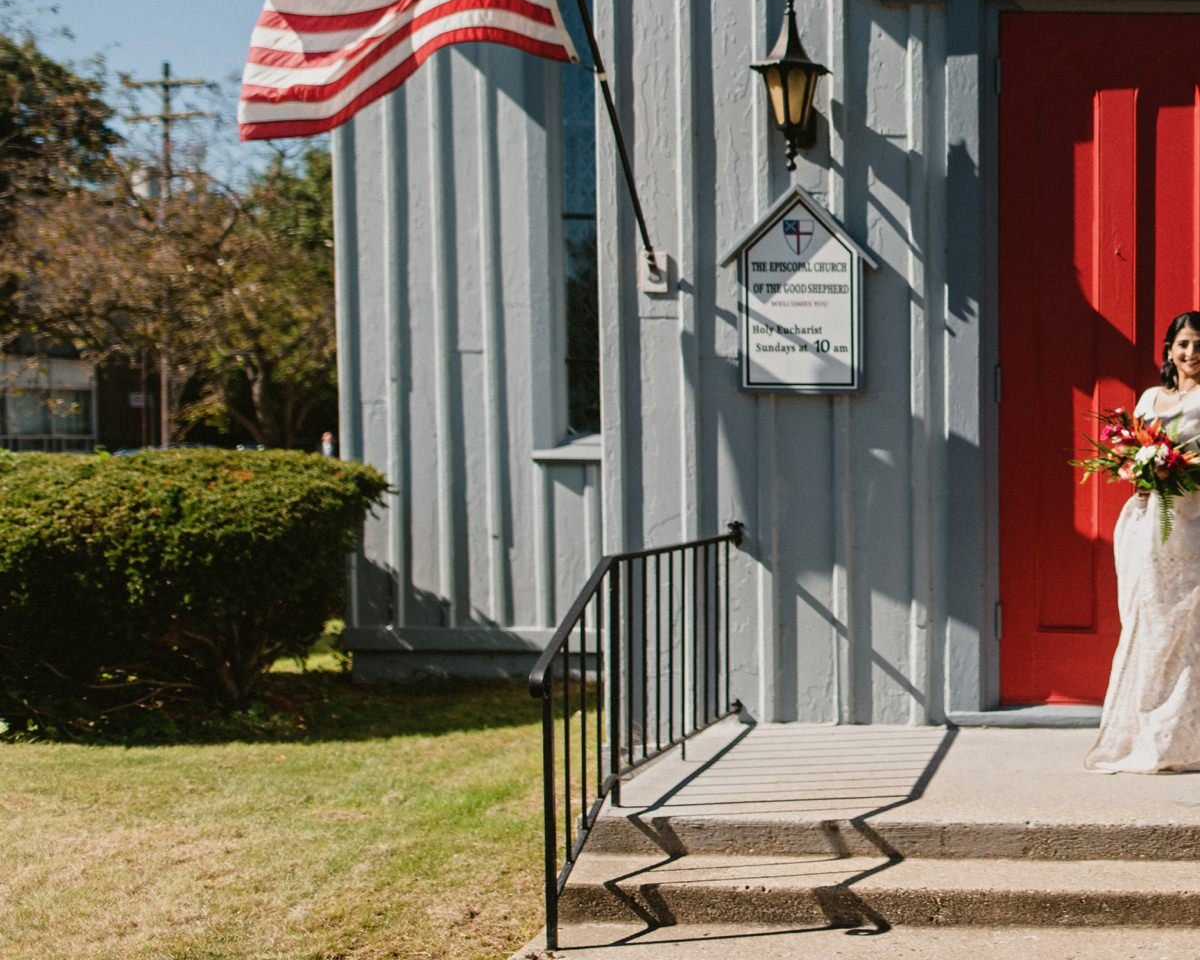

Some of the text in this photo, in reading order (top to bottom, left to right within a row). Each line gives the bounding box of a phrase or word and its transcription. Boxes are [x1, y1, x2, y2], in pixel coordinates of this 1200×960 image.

[752, 262, 847, 272] THE EPISCOPAL CHURCH
[753, 283, 849, 294] OF THE GOOD SHEPHERD
[753, 324, 822, 336] Holy Eucharist
[756, 342, 796, 354] Sundays
[799, 344, 808, 352] at
[815, 339, 831, 353] 10
